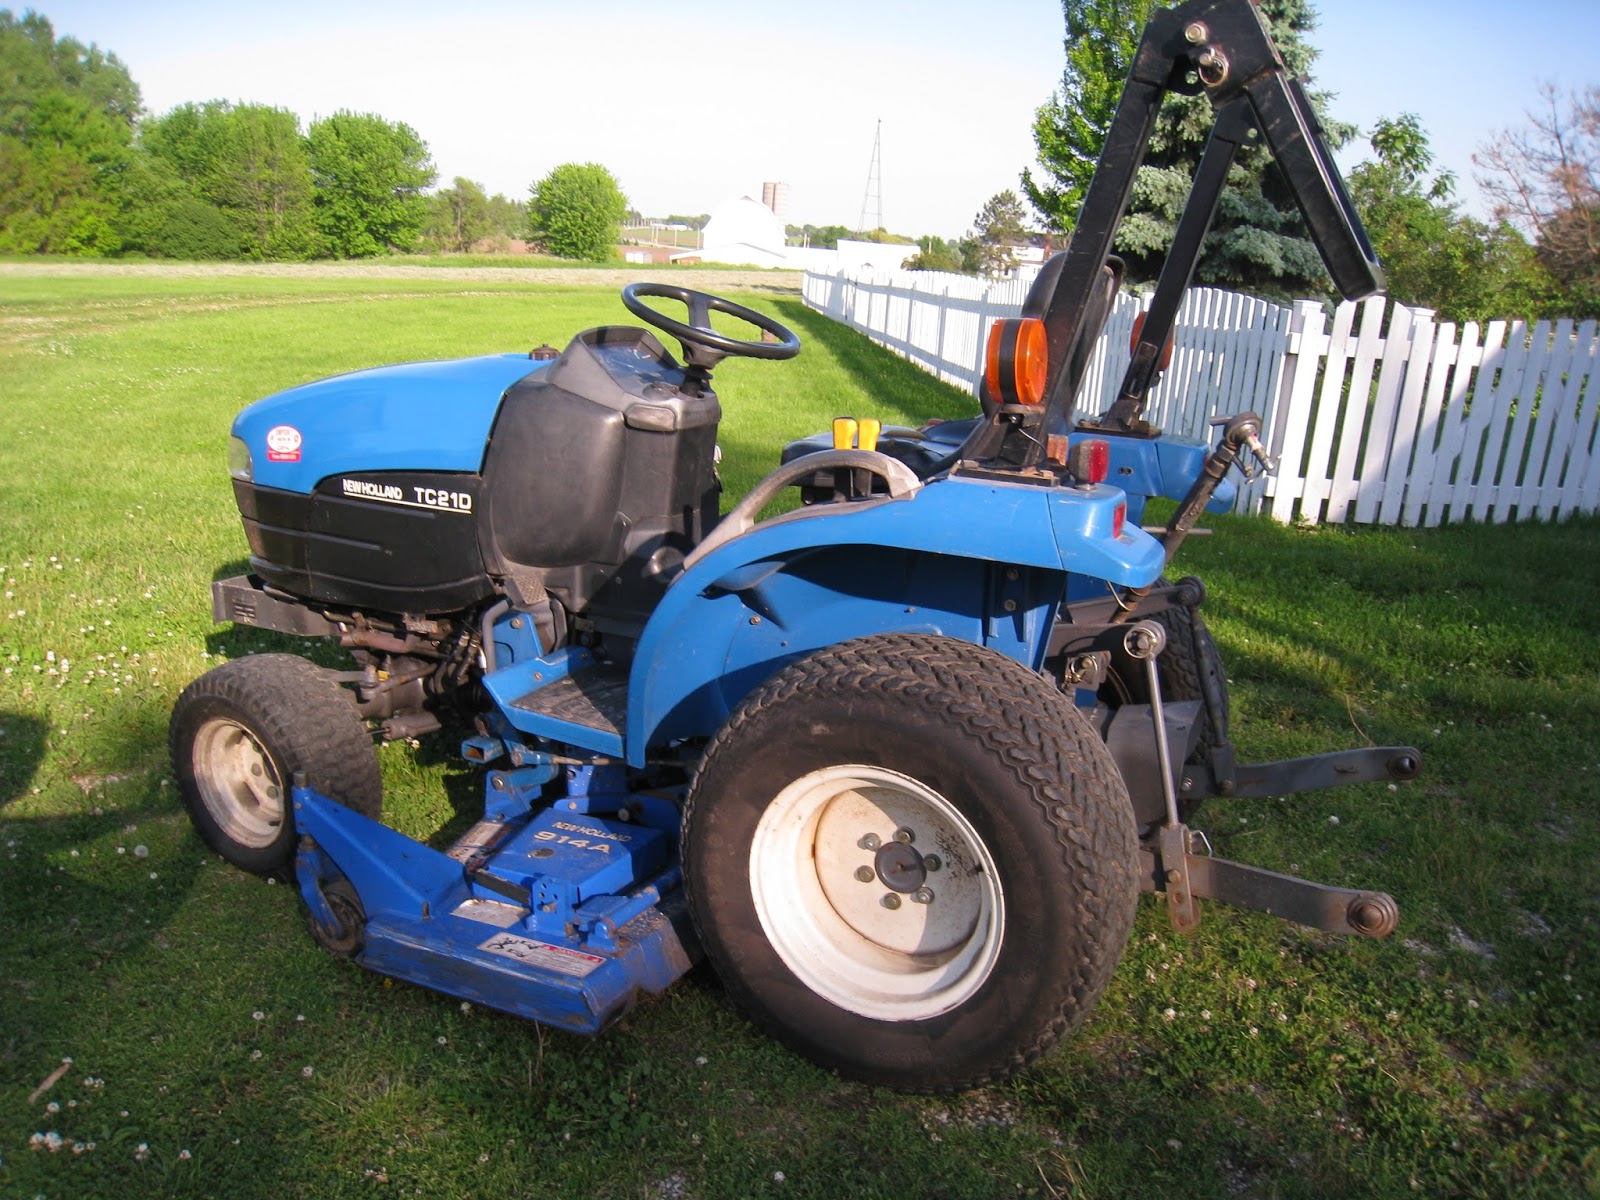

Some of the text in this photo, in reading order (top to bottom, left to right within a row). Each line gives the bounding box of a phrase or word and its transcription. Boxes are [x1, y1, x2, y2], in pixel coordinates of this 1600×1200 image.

[343, 479, 472, 509] NEW HOLLAND TC21D
[534, 831, 610, 854] 914A
[552, 821, 632, 842] NEW HOLLAND
